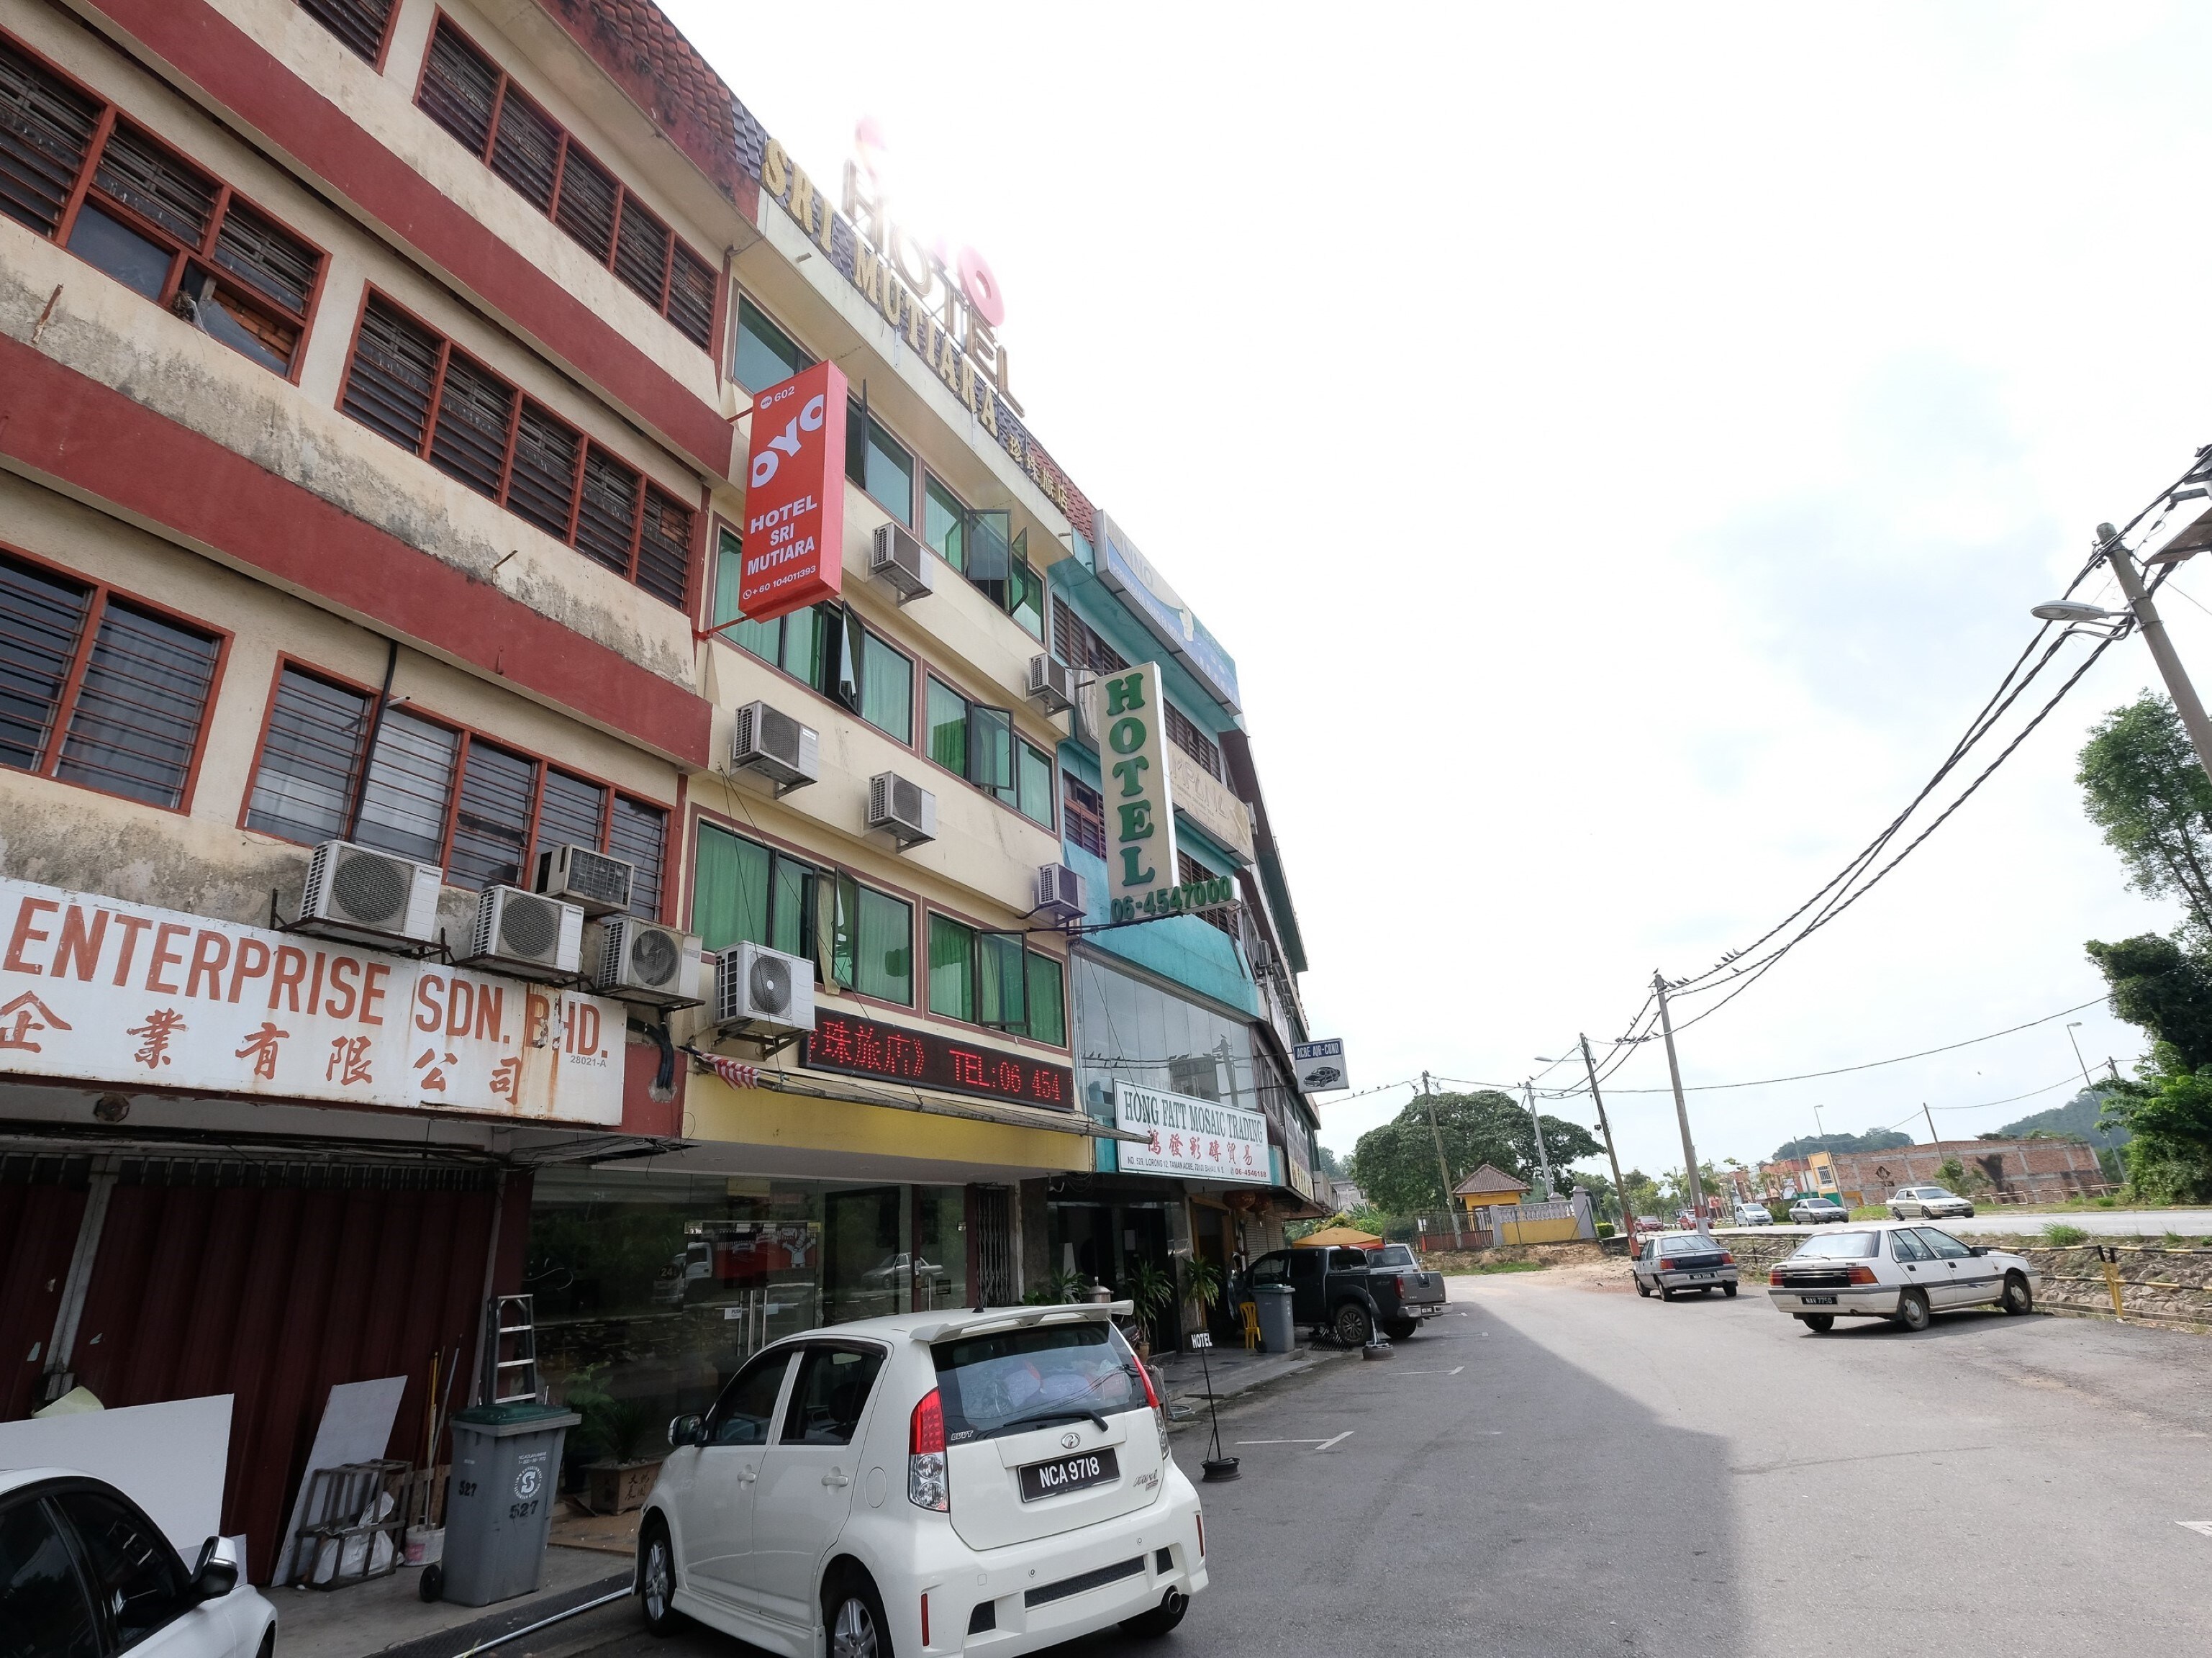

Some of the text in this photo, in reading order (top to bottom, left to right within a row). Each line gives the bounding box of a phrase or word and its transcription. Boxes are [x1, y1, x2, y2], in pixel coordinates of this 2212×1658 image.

[763, 139, 833, 253] SRI
[853, 237, 999, 438] MUTIARA
[842, 158, 1025, 417] HOTEL
[774, 386, 794, 402] 602
[751, 394, 825, 488] OYO
[750, 495, 817, 534] HOTEL
[770, 522, 794, 546] SRI
[747, 536, 815, 576] MUTIARA
[773, 565, 816, 588] 104011393
[1104, 672, 1156, 887] HOTEL
[419, 869, 441, 879] Panasonic
[1111, 876, 1233, 923] 06-4547000
[2, 897, 608, 1059] ENTERPRISE SDN. BHD.
[0, 990, 523, 1104] 企業有限公司
[570, 1055, 607, 1069] 28021-A
[1313, 1042, 1339, 1057] AIR-COND
[1123, 1091, 1263, 1143] HONG FATT MOSAIC TRADING
[1191, 1333, 1212, 1349] HOTEL
[1039, 1457, 1100, 1488] NCA 9718
[509, 1500, 540, 1519] 527
